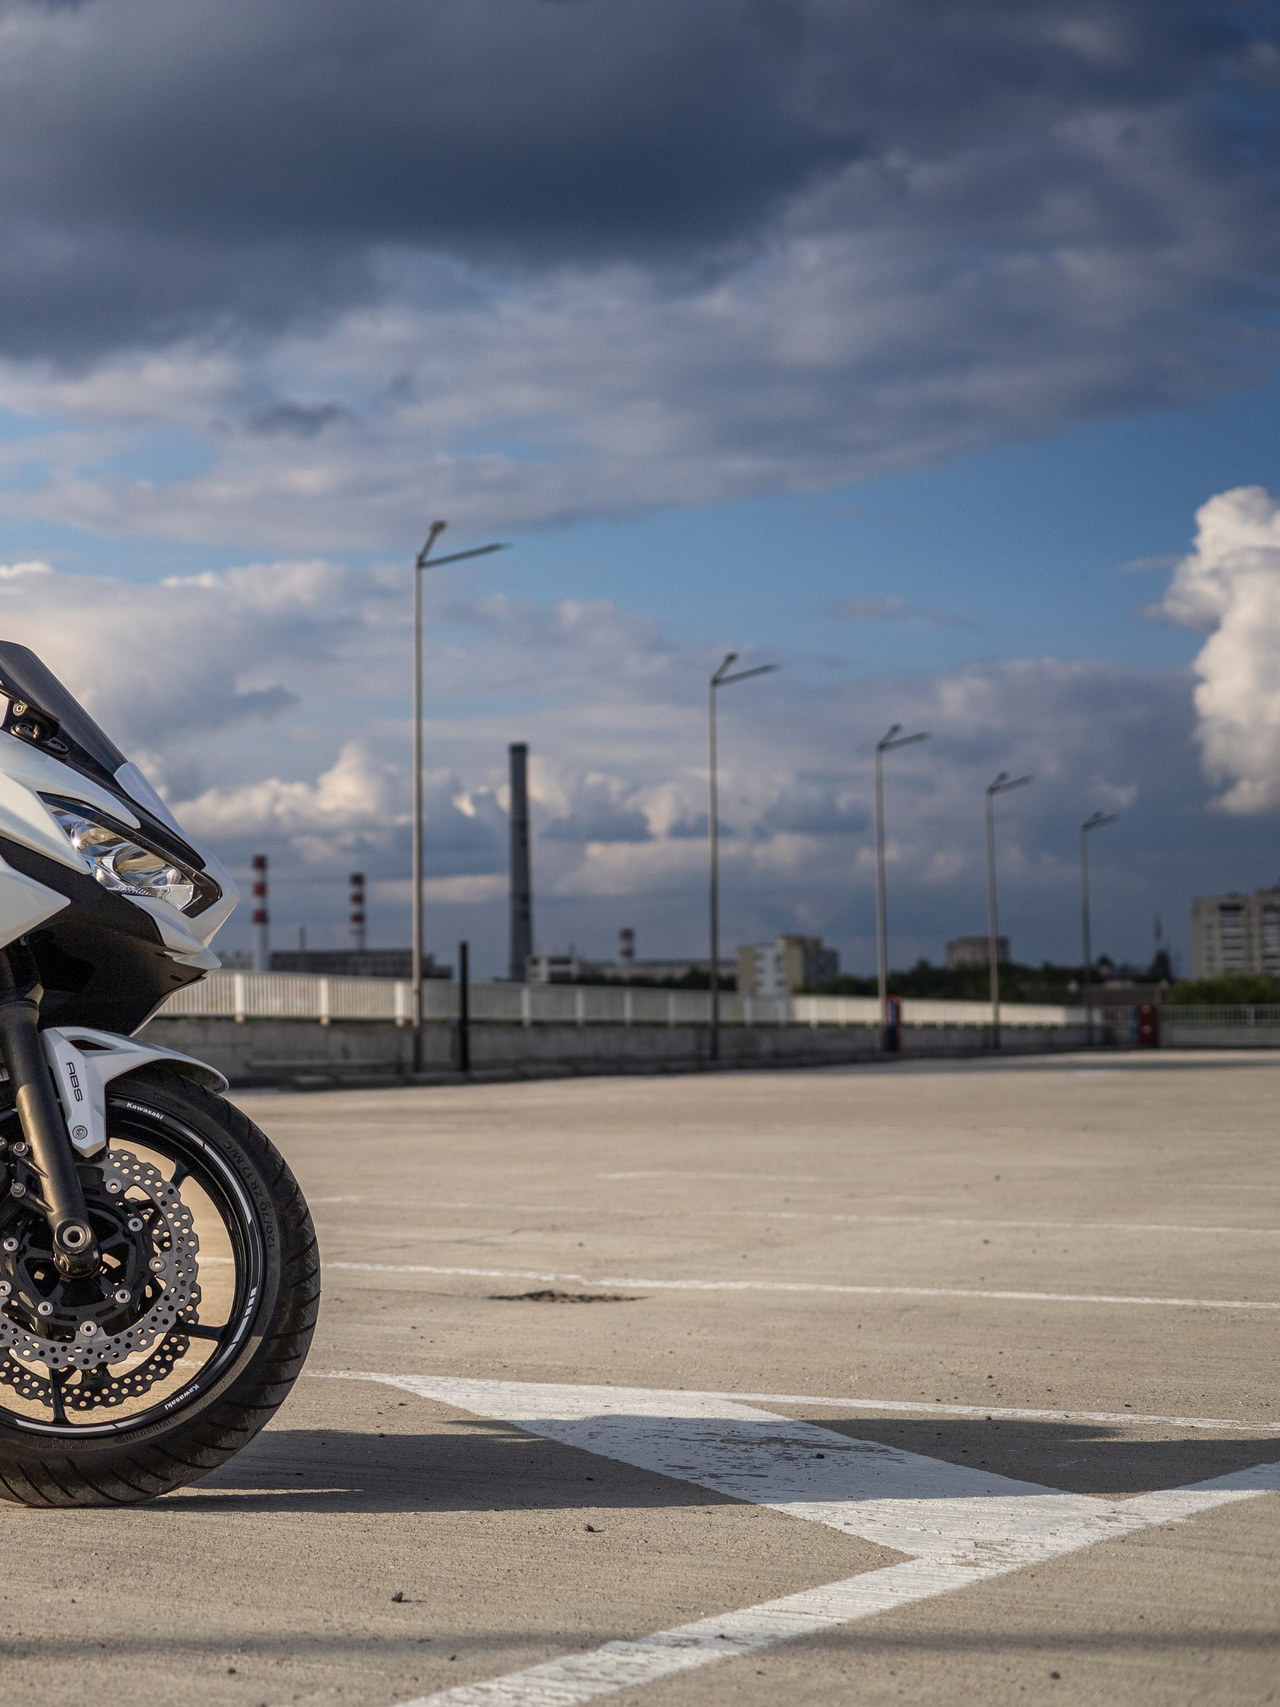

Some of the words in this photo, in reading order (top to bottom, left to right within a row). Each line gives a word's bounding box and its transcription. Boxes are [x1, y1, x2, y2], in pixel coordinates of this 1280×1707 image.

[66, 1062, 84, 1102] ABS
[126, 1102, 164, 1120] Kawasaki
[260, 1201, 276, 1249] 120/70
[163, 1383, 201, 1411] Kawasaki
